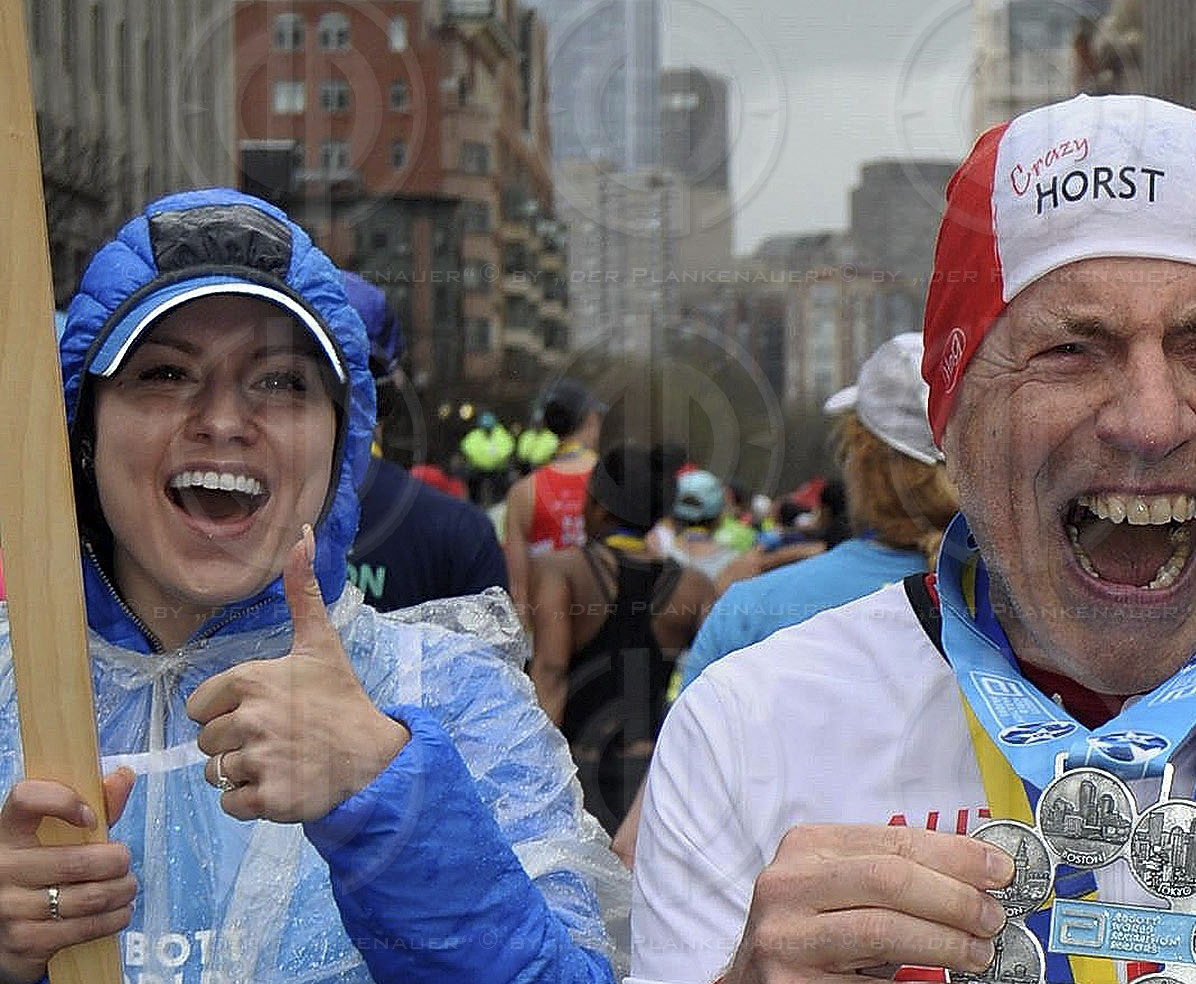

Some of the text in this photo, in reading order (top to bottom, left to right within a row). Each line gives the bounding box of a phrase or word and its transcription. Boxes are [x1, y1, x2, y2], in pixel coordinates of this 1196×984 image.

[1011, 137, 1089, 196] Crazy
[1035, 165, 1165, 215] HORST
[1157, 882, 1193, 896] TOKYO
